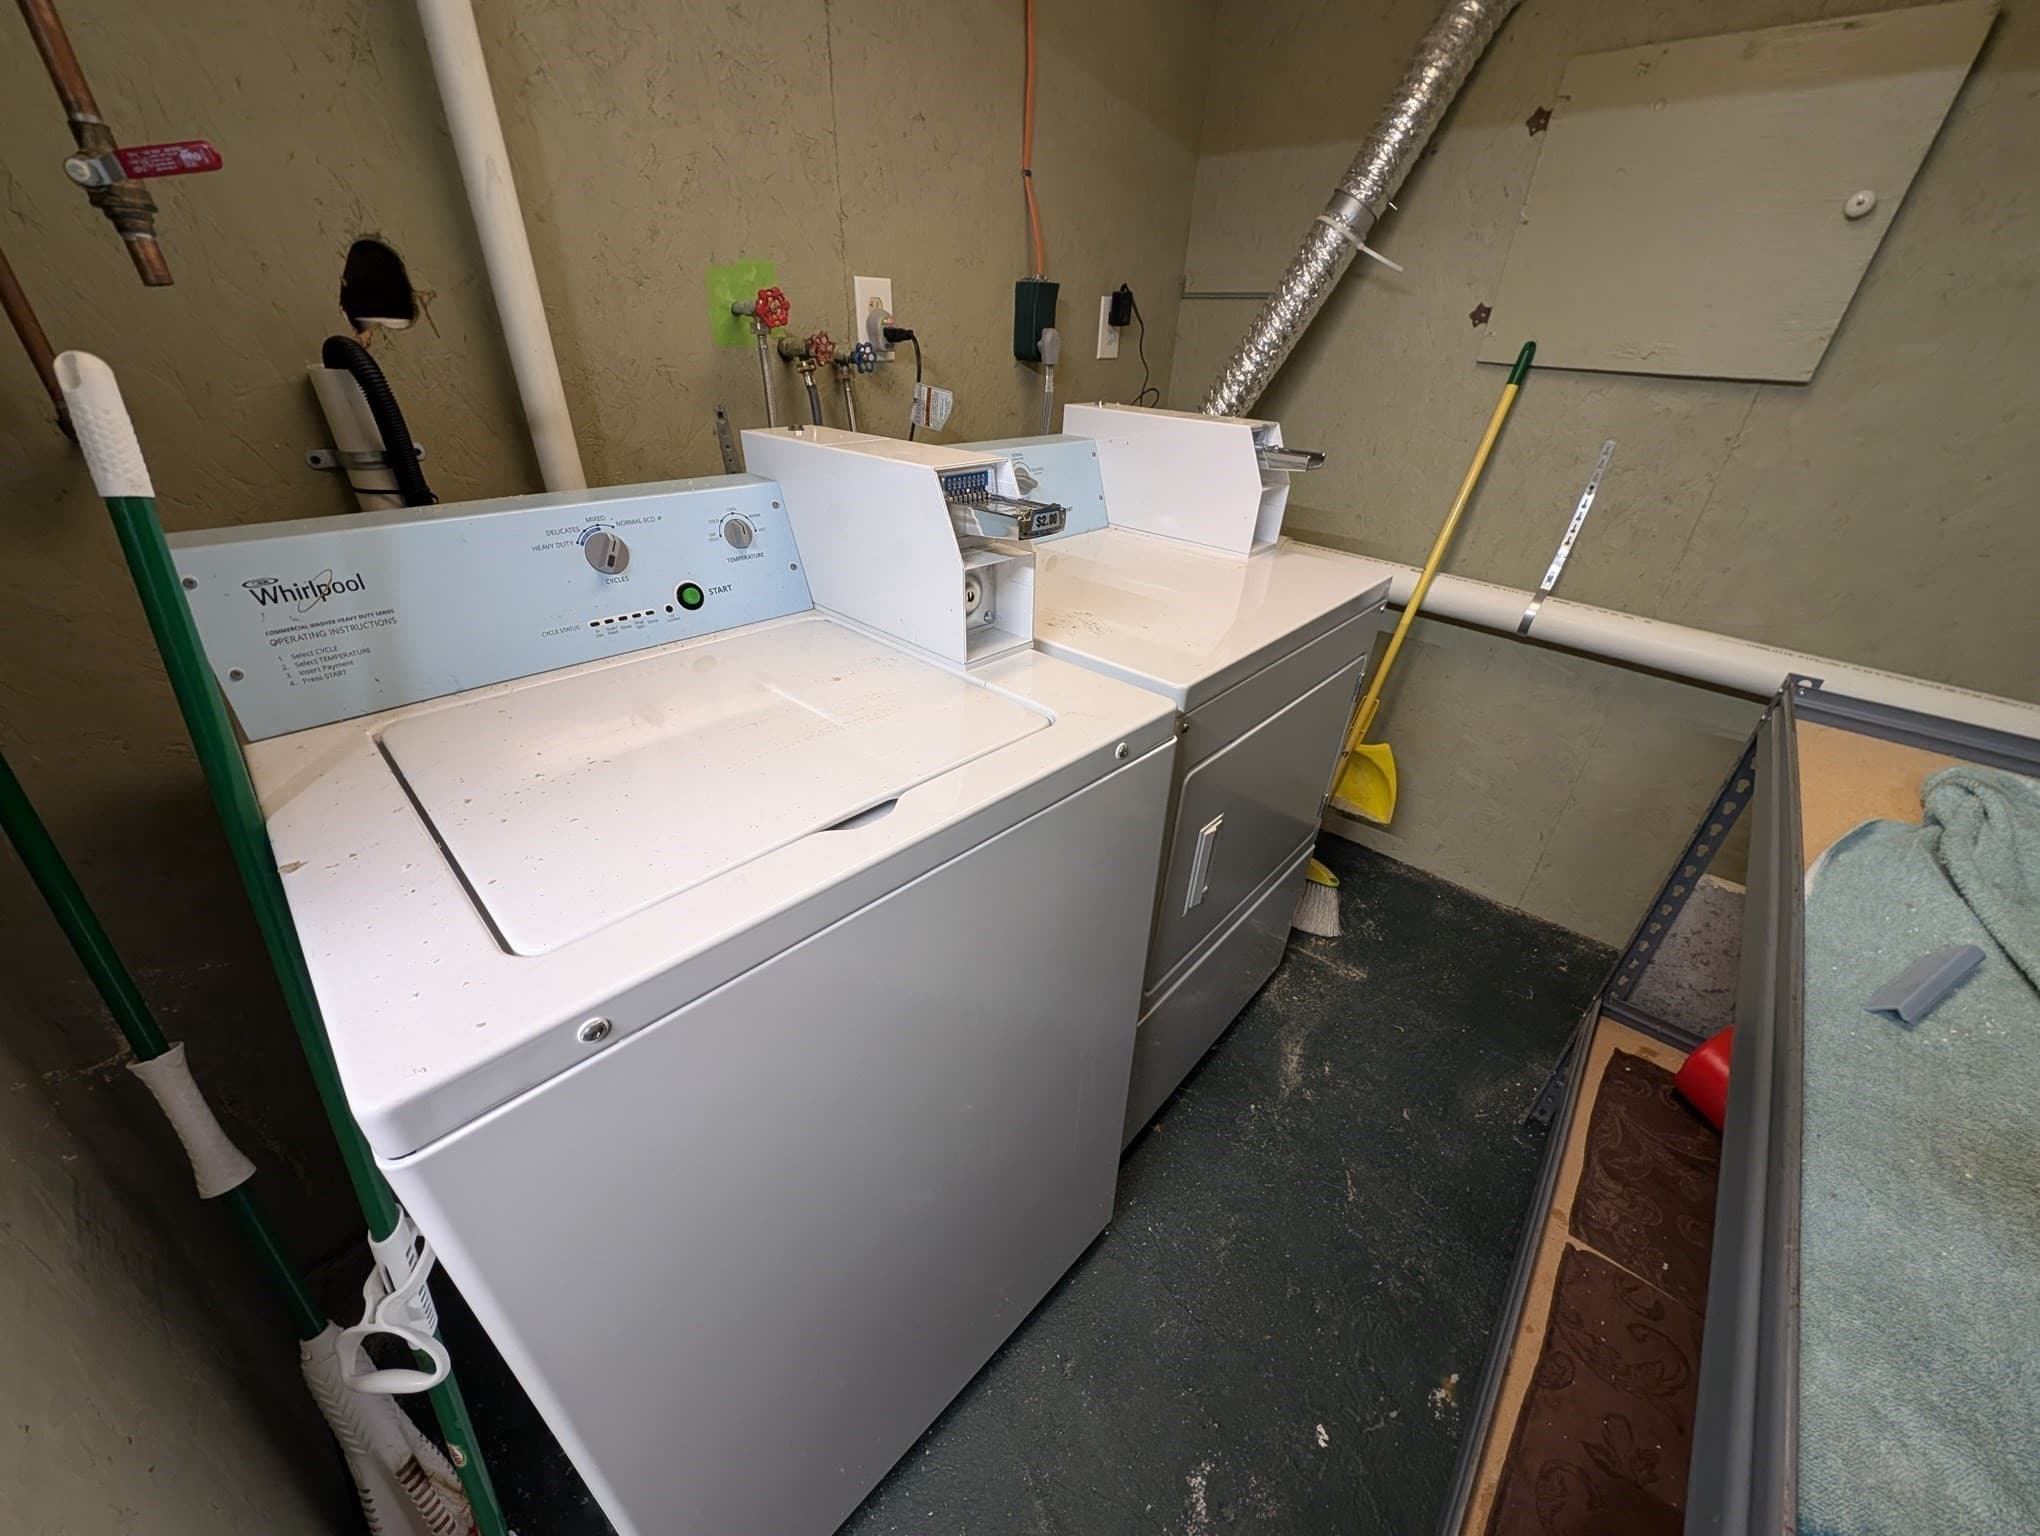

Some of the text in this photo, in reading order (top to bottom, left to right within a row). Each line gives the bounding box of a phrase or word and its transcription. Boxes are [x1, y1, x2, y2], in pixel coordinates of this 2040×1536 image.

[616, 518, 643, 527] NORMAL
[1036, 513, 1058, 528] $2.00
[546, 526, 581, 536] DELICATES
[532, 539, 574, 552] HEAVY DUTY
[726, 552, 765, 564] TEMPERATURE
[605, 575, 630, 585] CYCLES
[250, 573, 366, 606] Whirlpool
[708, 584, 732, 596] START
[265, 609, 395, 636] COMMERCIAL WASHER HEAVY DUTY SERIES
[270, 617, 398, 647] OPERATING INSTRUCTIONS
[541, 624, 581, 638] CYCLE STATUS
[290, 650, 314, 660] Select
[314, 645, 338, 655] CYCLE
[294, 659, 318, 669] Select
[318, 648, 371, 663] TEMPERATURE
[298, 667, 322, 677] Insert
[322, 660, 354, 672] Payment
[302, 675, 324, 685] Press
[324, 670, 347, 680] START
